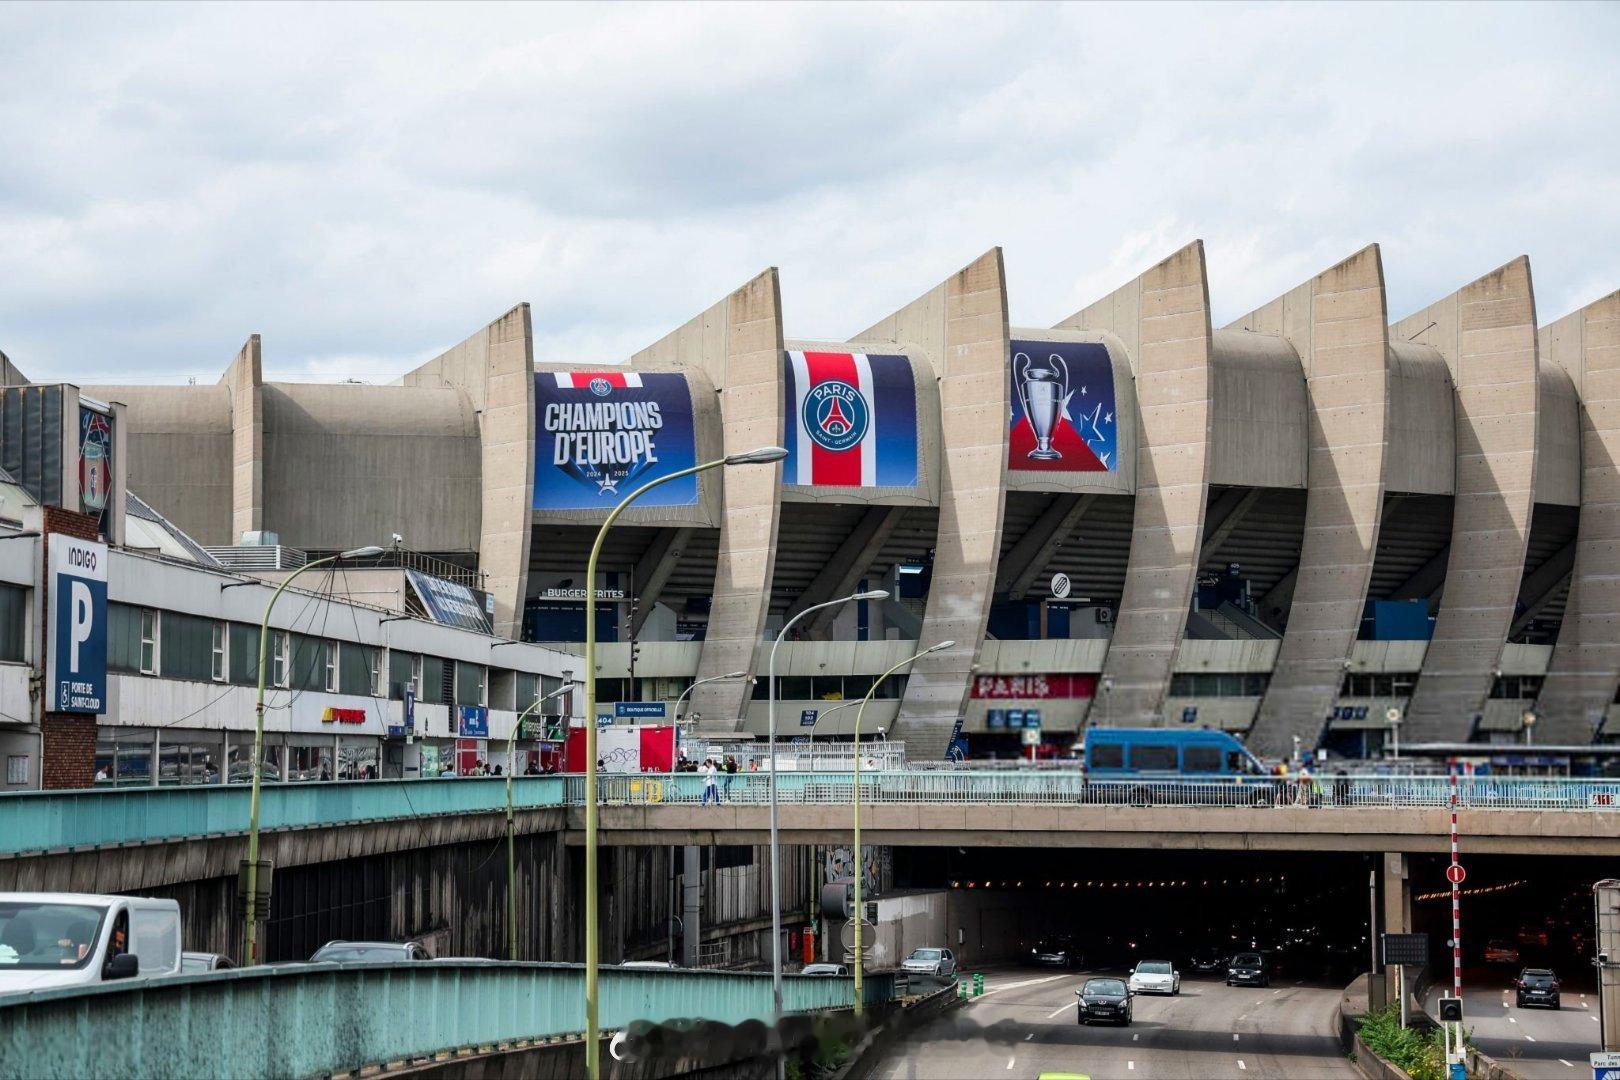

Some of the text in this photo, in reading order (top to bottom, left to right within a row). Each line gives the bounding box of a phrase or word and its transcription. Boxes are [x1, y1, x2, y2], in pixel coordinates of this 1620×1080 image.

[814, 384, 856, 402] PARIS
[544, 401, 663, 431] CHAMPIONS
[816, 429, 857, 445] SAINT GERMAIN
[553, 430, 659, 466] D'EUROPE
[68, 546, 97, 572] INDIGO
[547, 588, 587, 598] BURGER
[70, 580, 93, 673] P
[71, 682, 93, 695] PORTE DE
[71, 696, 100, 709] SAINT-CLOUD
